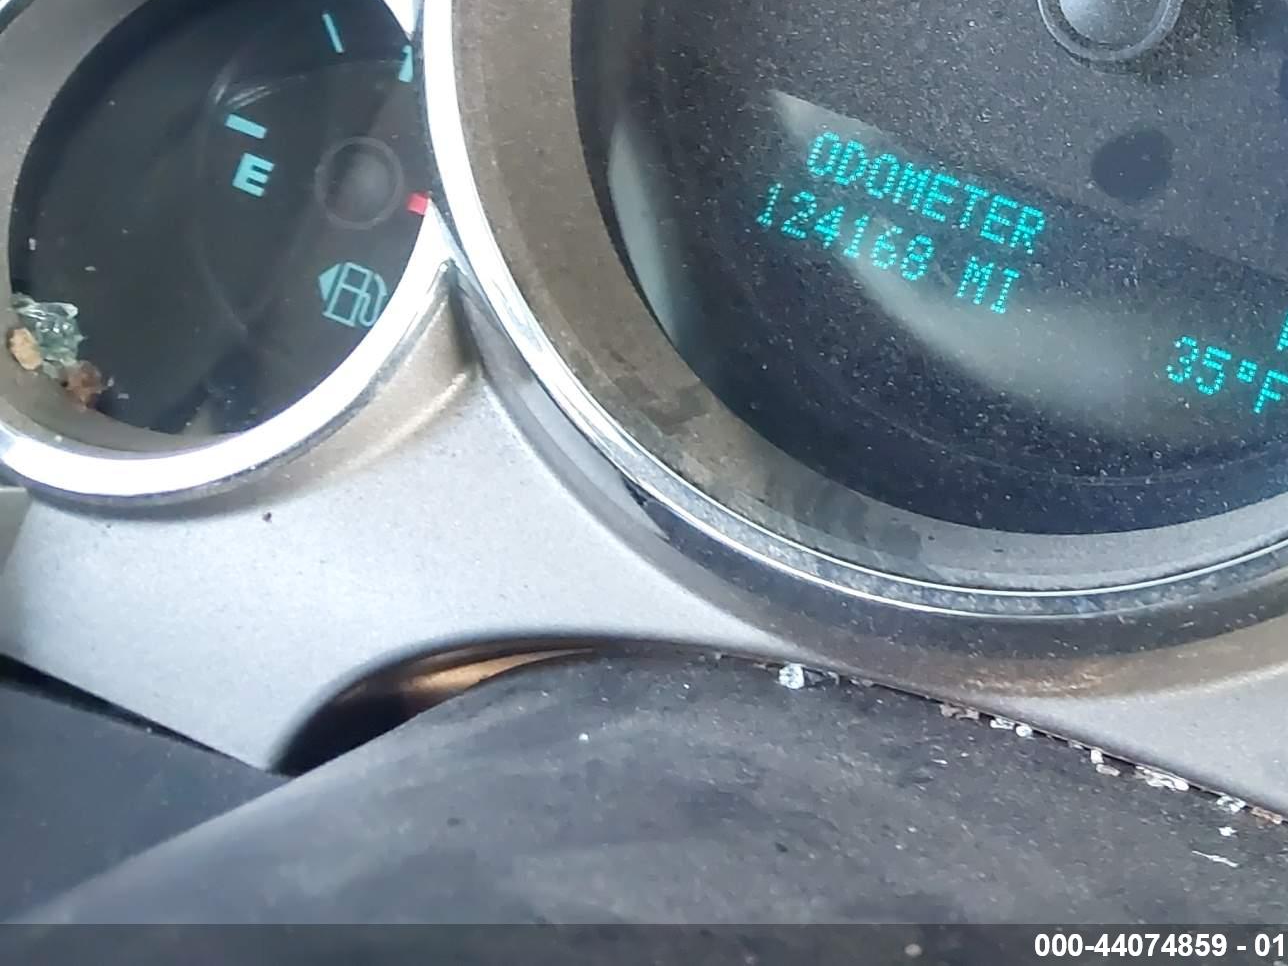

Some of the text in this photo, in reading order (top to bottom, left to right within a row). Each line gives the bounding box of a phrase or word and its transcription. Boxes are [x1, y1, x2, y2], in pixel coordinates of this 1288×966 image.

[233, 154, 273, 196] E
[806, 131, 1046, 257] ODOMETER
[755, 181, 1020, 314] 124168 MI
